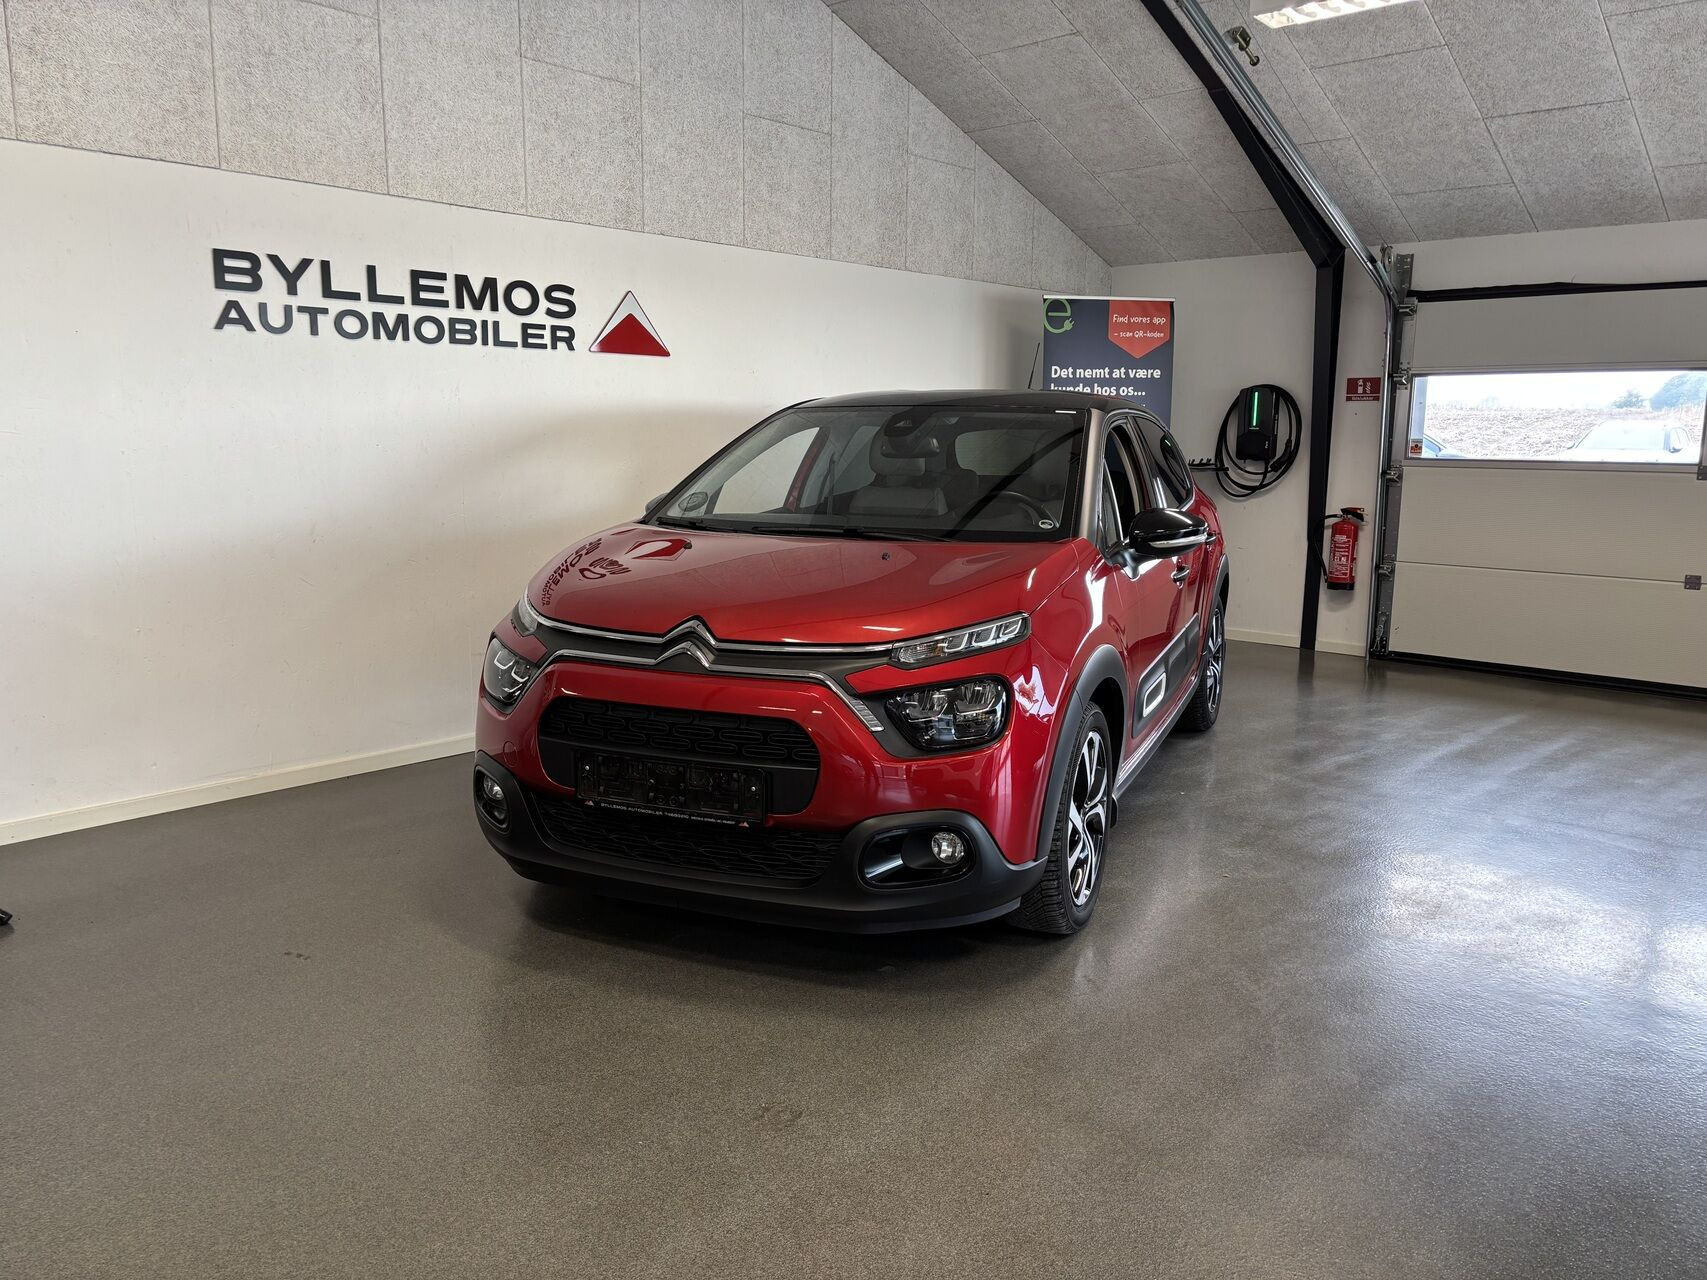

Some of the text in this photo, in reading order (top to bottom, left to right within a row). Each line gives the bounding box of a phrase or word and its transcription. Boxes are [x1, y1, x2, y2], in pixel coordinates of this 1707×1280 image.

[212, 248, 577, 319] BYLLEMOS
[214, 299, 576, 351] AUTOMOBILER
[1113, 314, 1167, 325] Find vores app
[1134, 330, 1165, 338] QR-koden
[1051, 365, 1162, 378] Det nemt at være
[1094, 383, 1117, 396] hos
